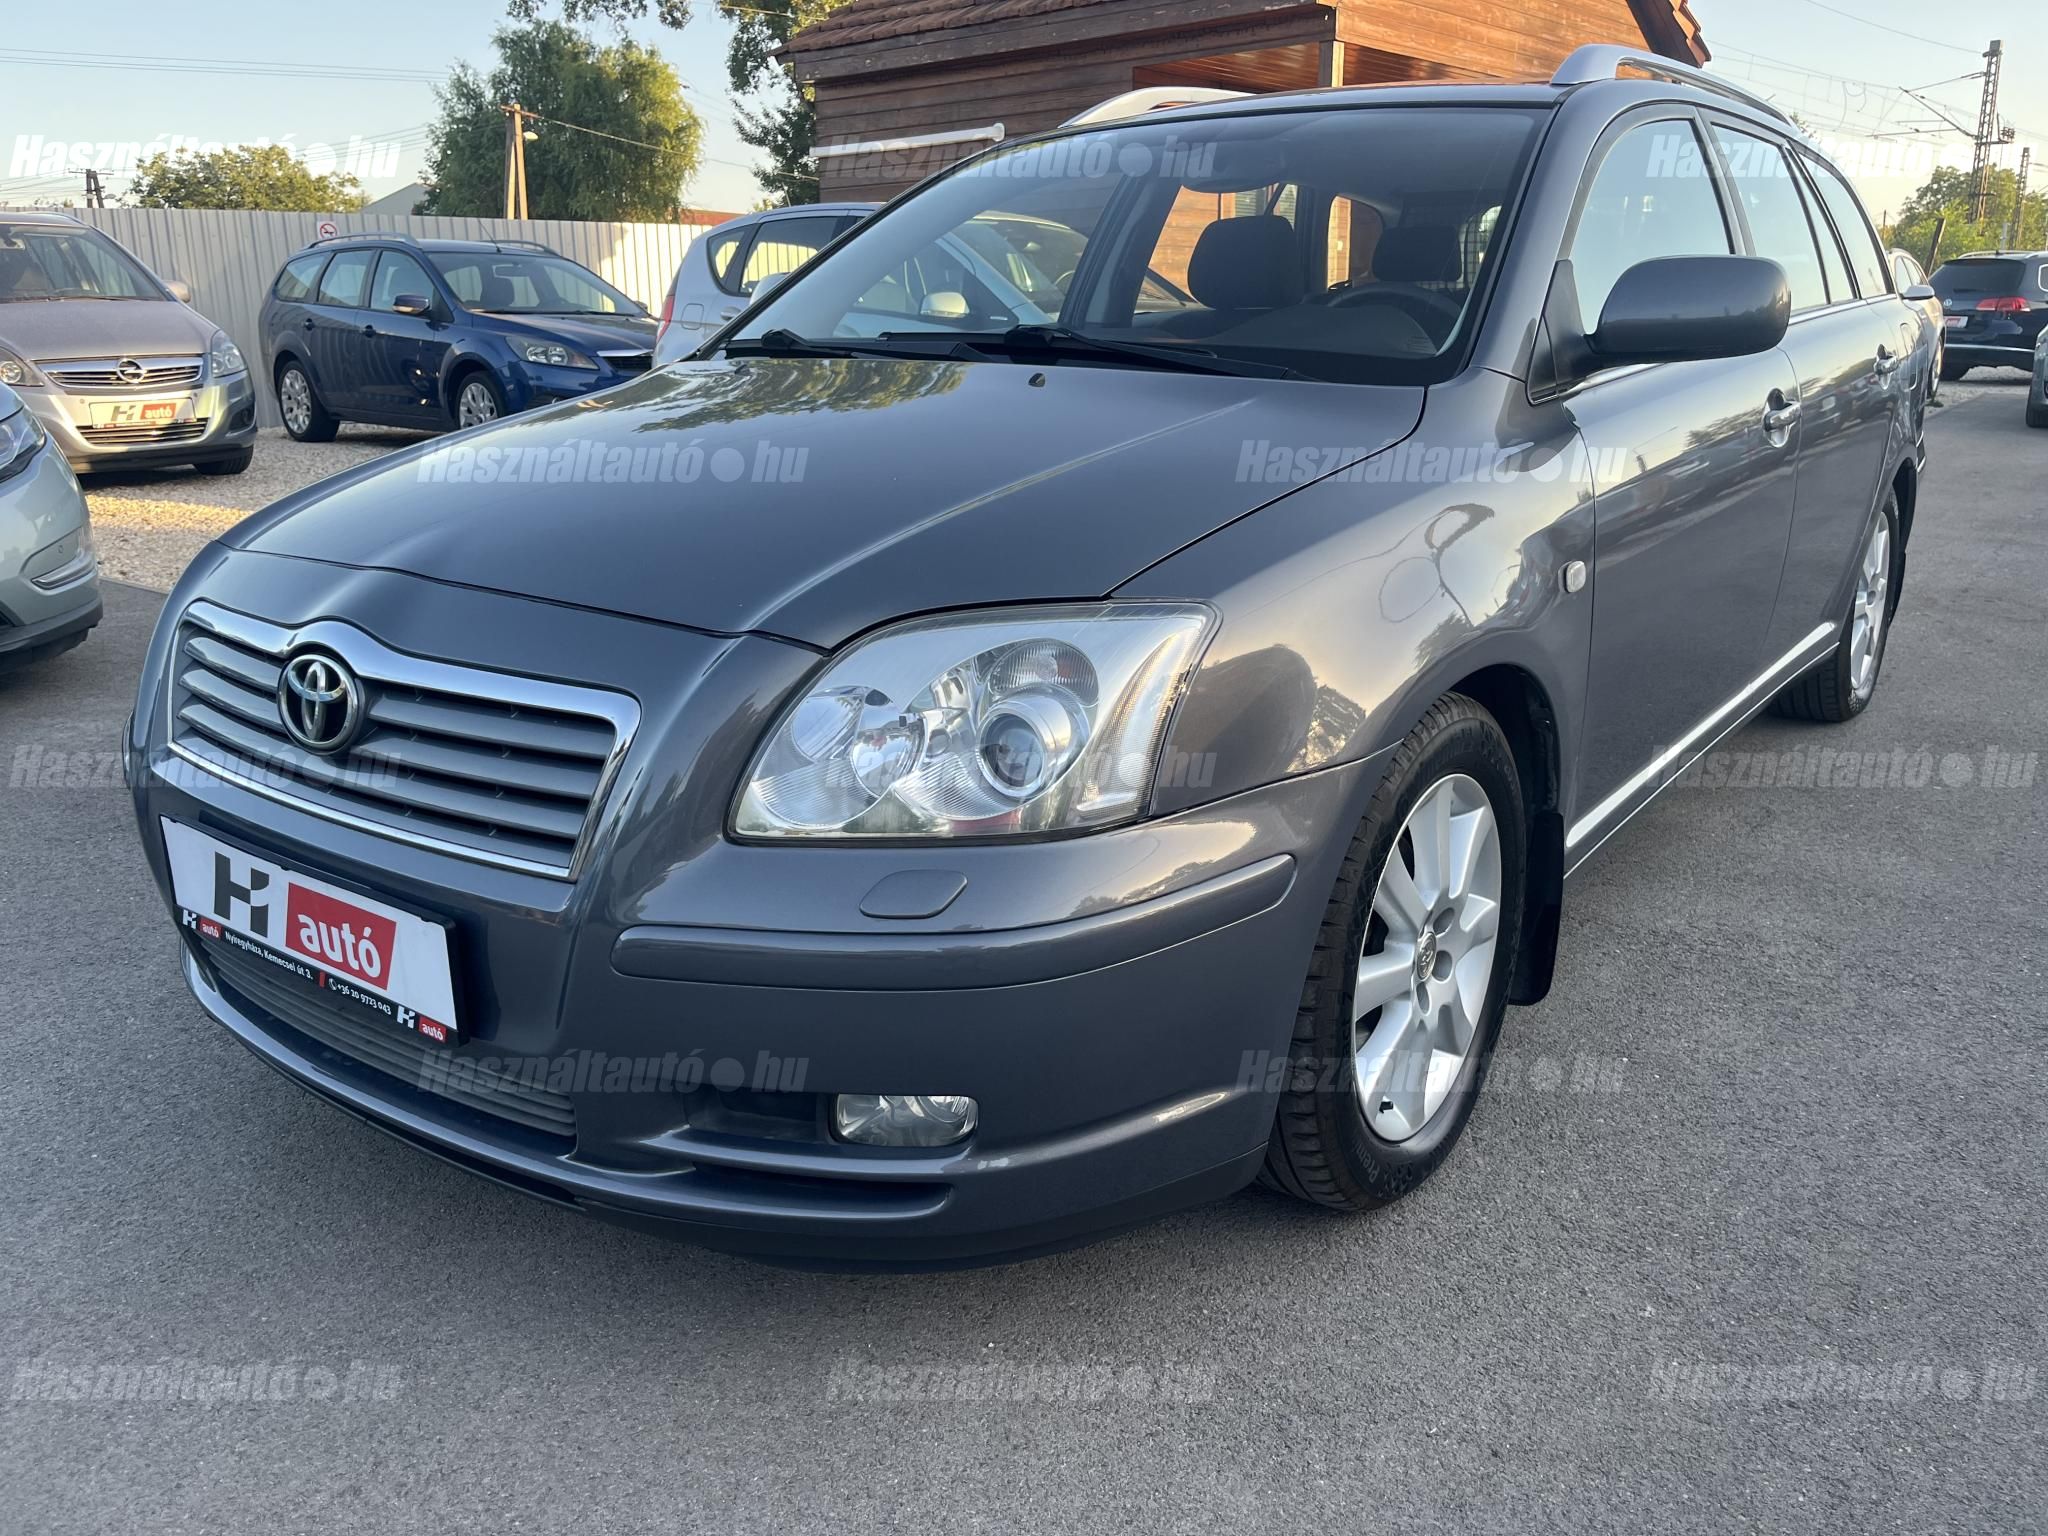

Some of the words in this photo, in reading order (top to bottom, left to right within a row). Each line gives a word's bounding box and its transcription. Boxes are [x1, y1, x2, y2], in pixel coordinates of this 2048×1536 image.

[145, 405, 173, 419] autó
[202, 923, 220, 938] autó
[298, 914, 382, 979] autó
[422, 1023, 444, 1041] autó
